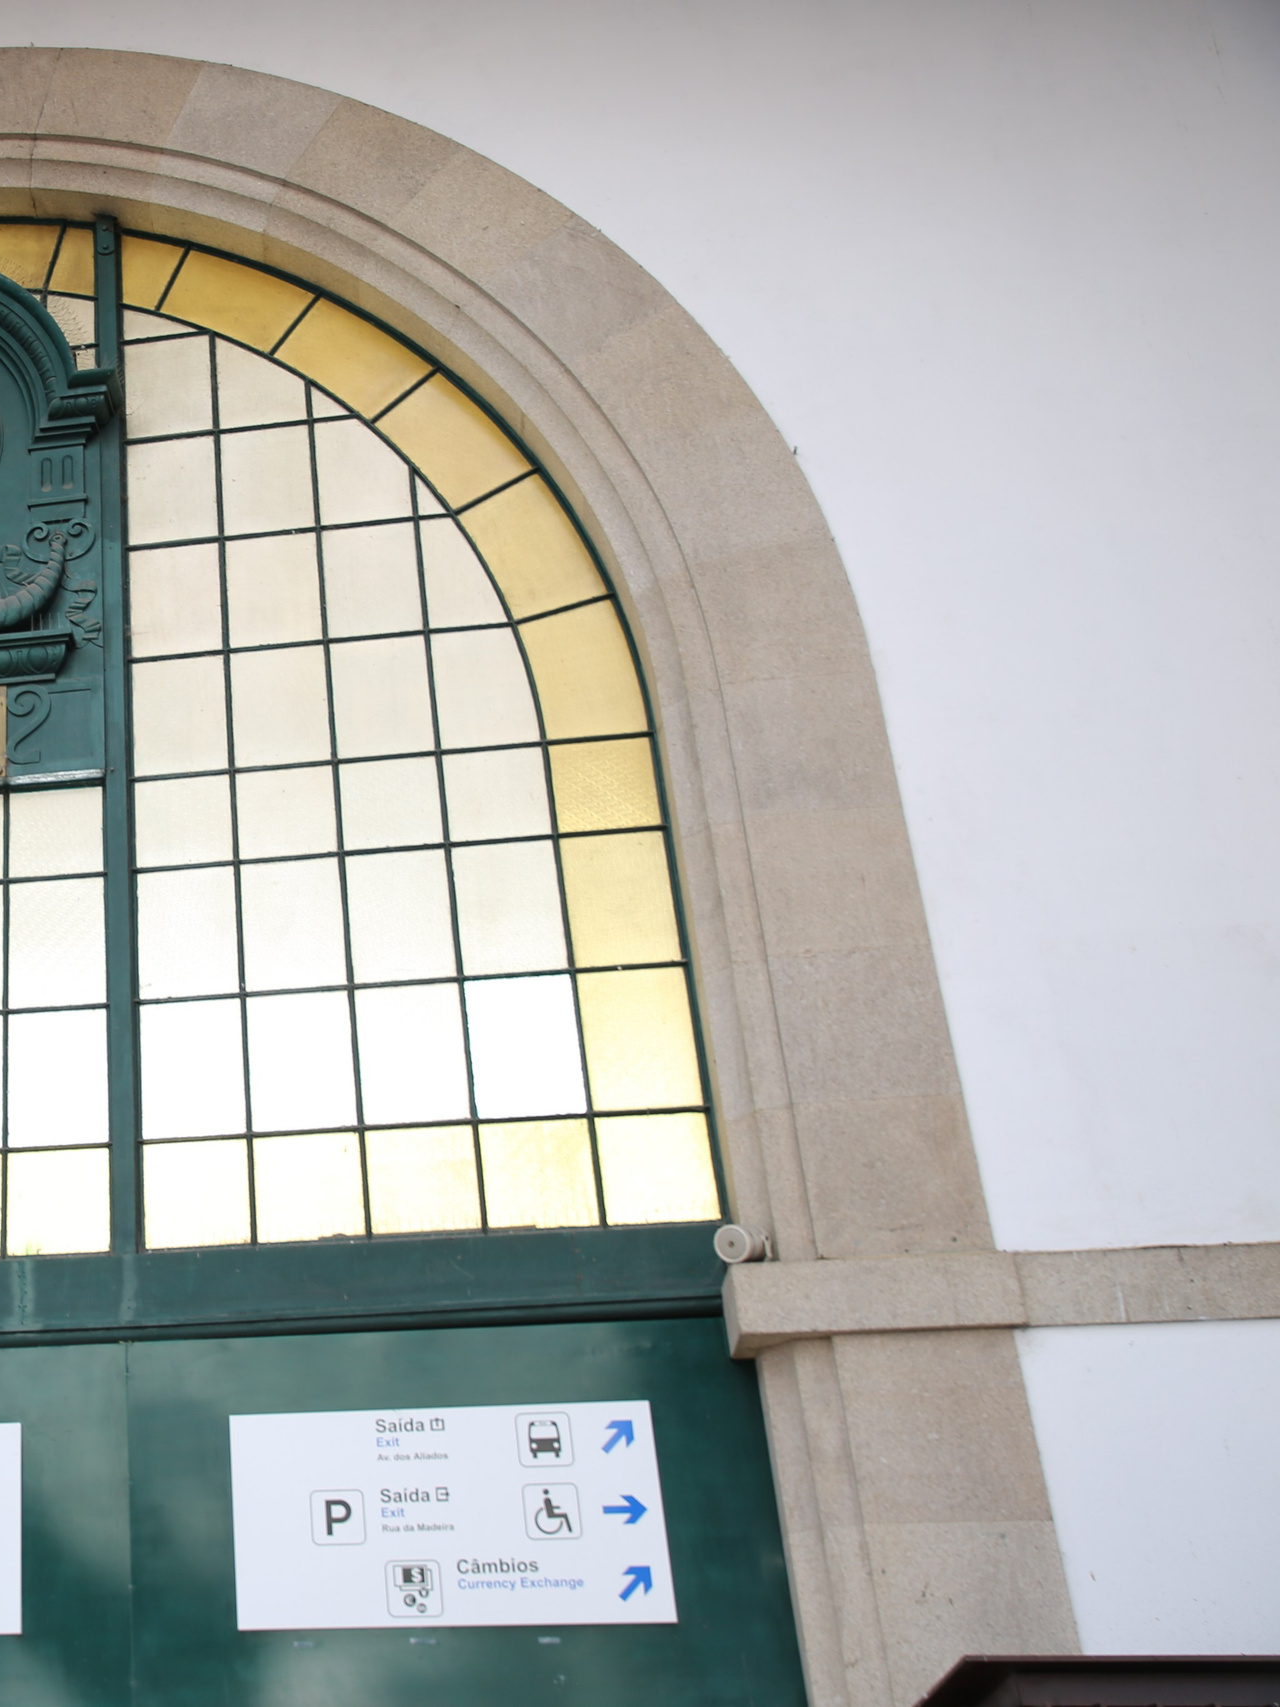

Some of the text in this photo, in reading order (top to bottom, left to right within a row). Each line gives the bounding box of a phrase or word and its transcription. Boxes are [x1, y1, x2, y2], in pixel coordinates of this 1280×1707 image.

[375, 1417, 425, 1433] Saída
[376, 1436, 400, 1448] Exit
[377, 1451, 449, 1461] Av. dos Aliados
[379, 1487, 431, 1503] Saída
[325, 1499, 352, 1536] P
[381, 1507, 405, 1518] Exit
[382, 1523, 454, 1533] Rua da Madeira
[457, 1557, 539, 1575] Câmbios
[457, 1575, 584, 1592] Currency Exchange
